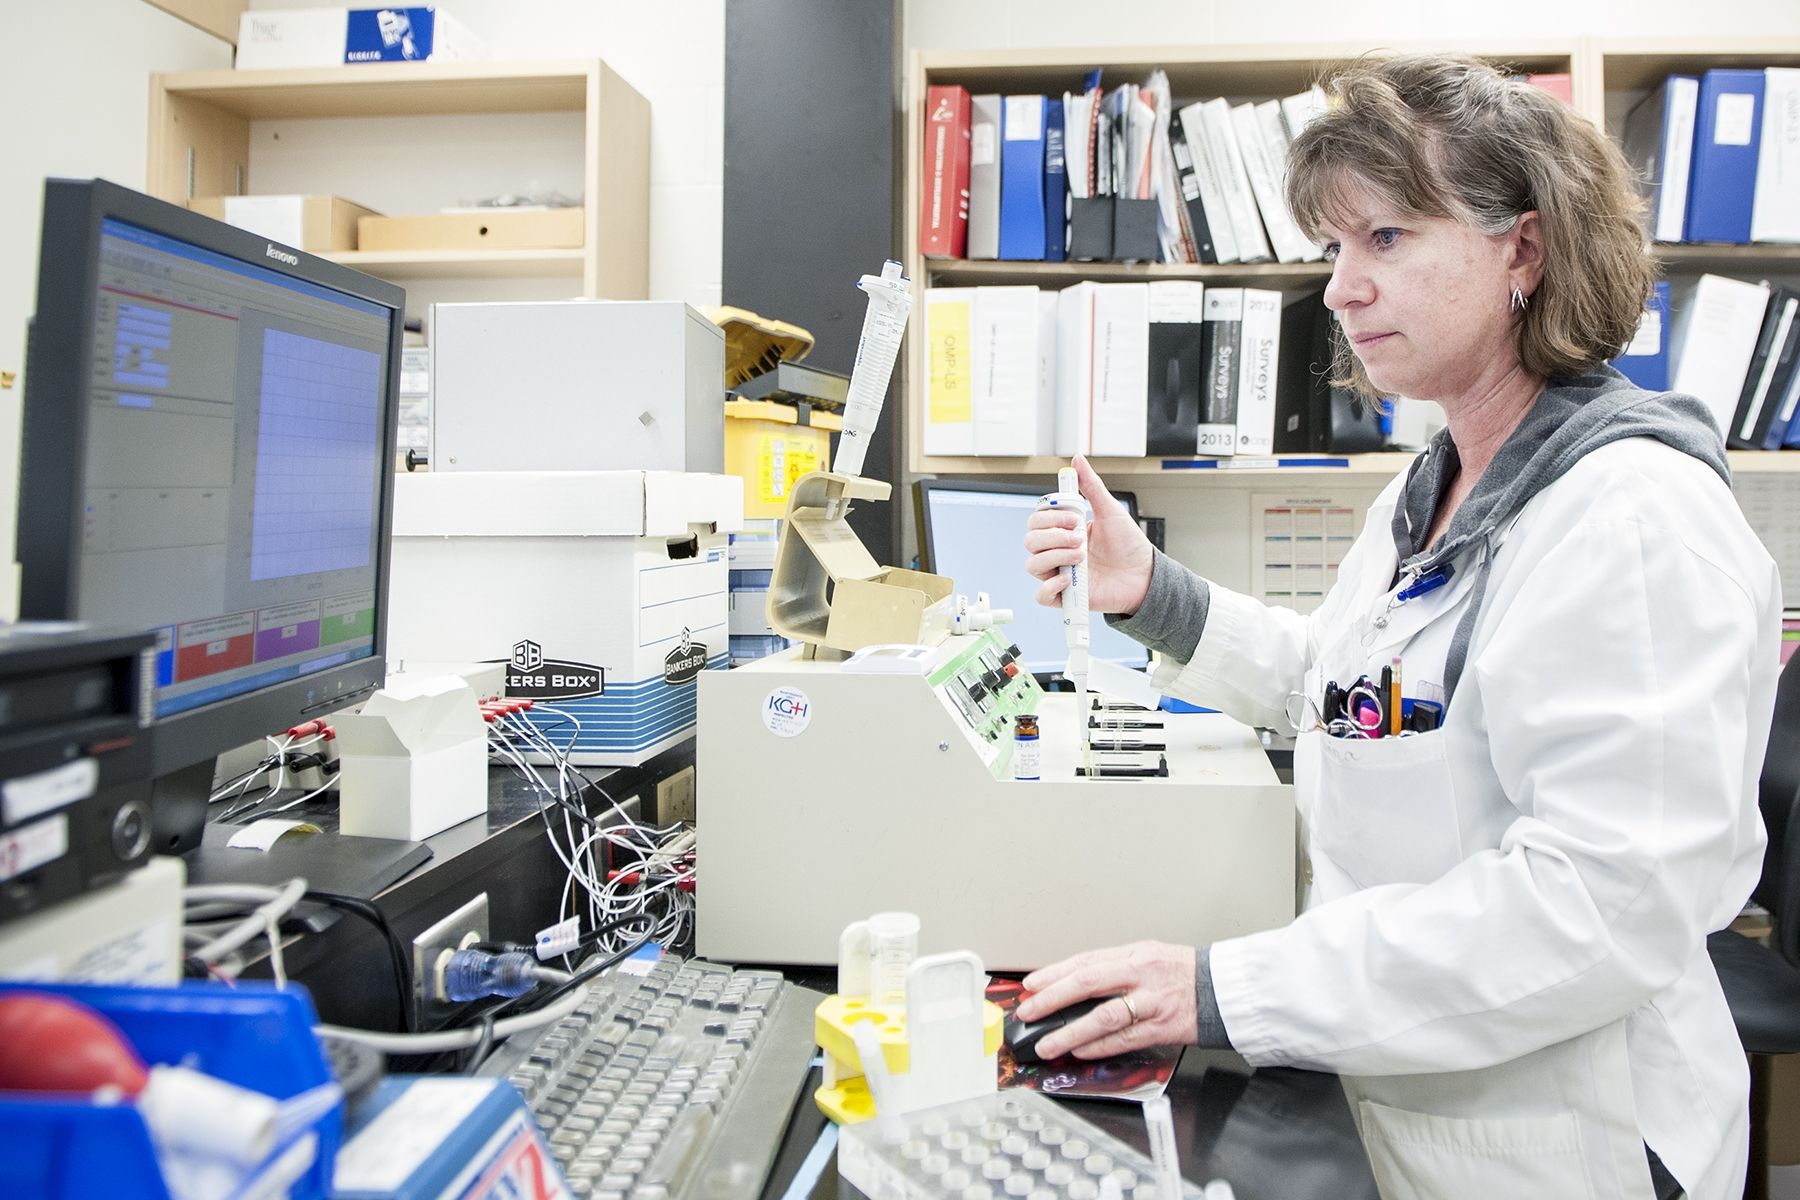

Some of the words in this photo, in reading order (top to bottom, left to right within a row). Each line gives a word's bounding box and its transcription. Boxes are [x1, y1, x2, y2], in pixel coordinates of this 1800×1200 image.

[266, 244, 298, 266] lenovo
[1249, 300, 1276, 312] 2012
[1215, 346, 1232, 399] Surveys
[1255, 338, 1273, 401] Surveys
[1201, 433, 1232, 446] 2013
[515, 643, 541, 667] BB
[666, 657, 692, 676] BANKERS
